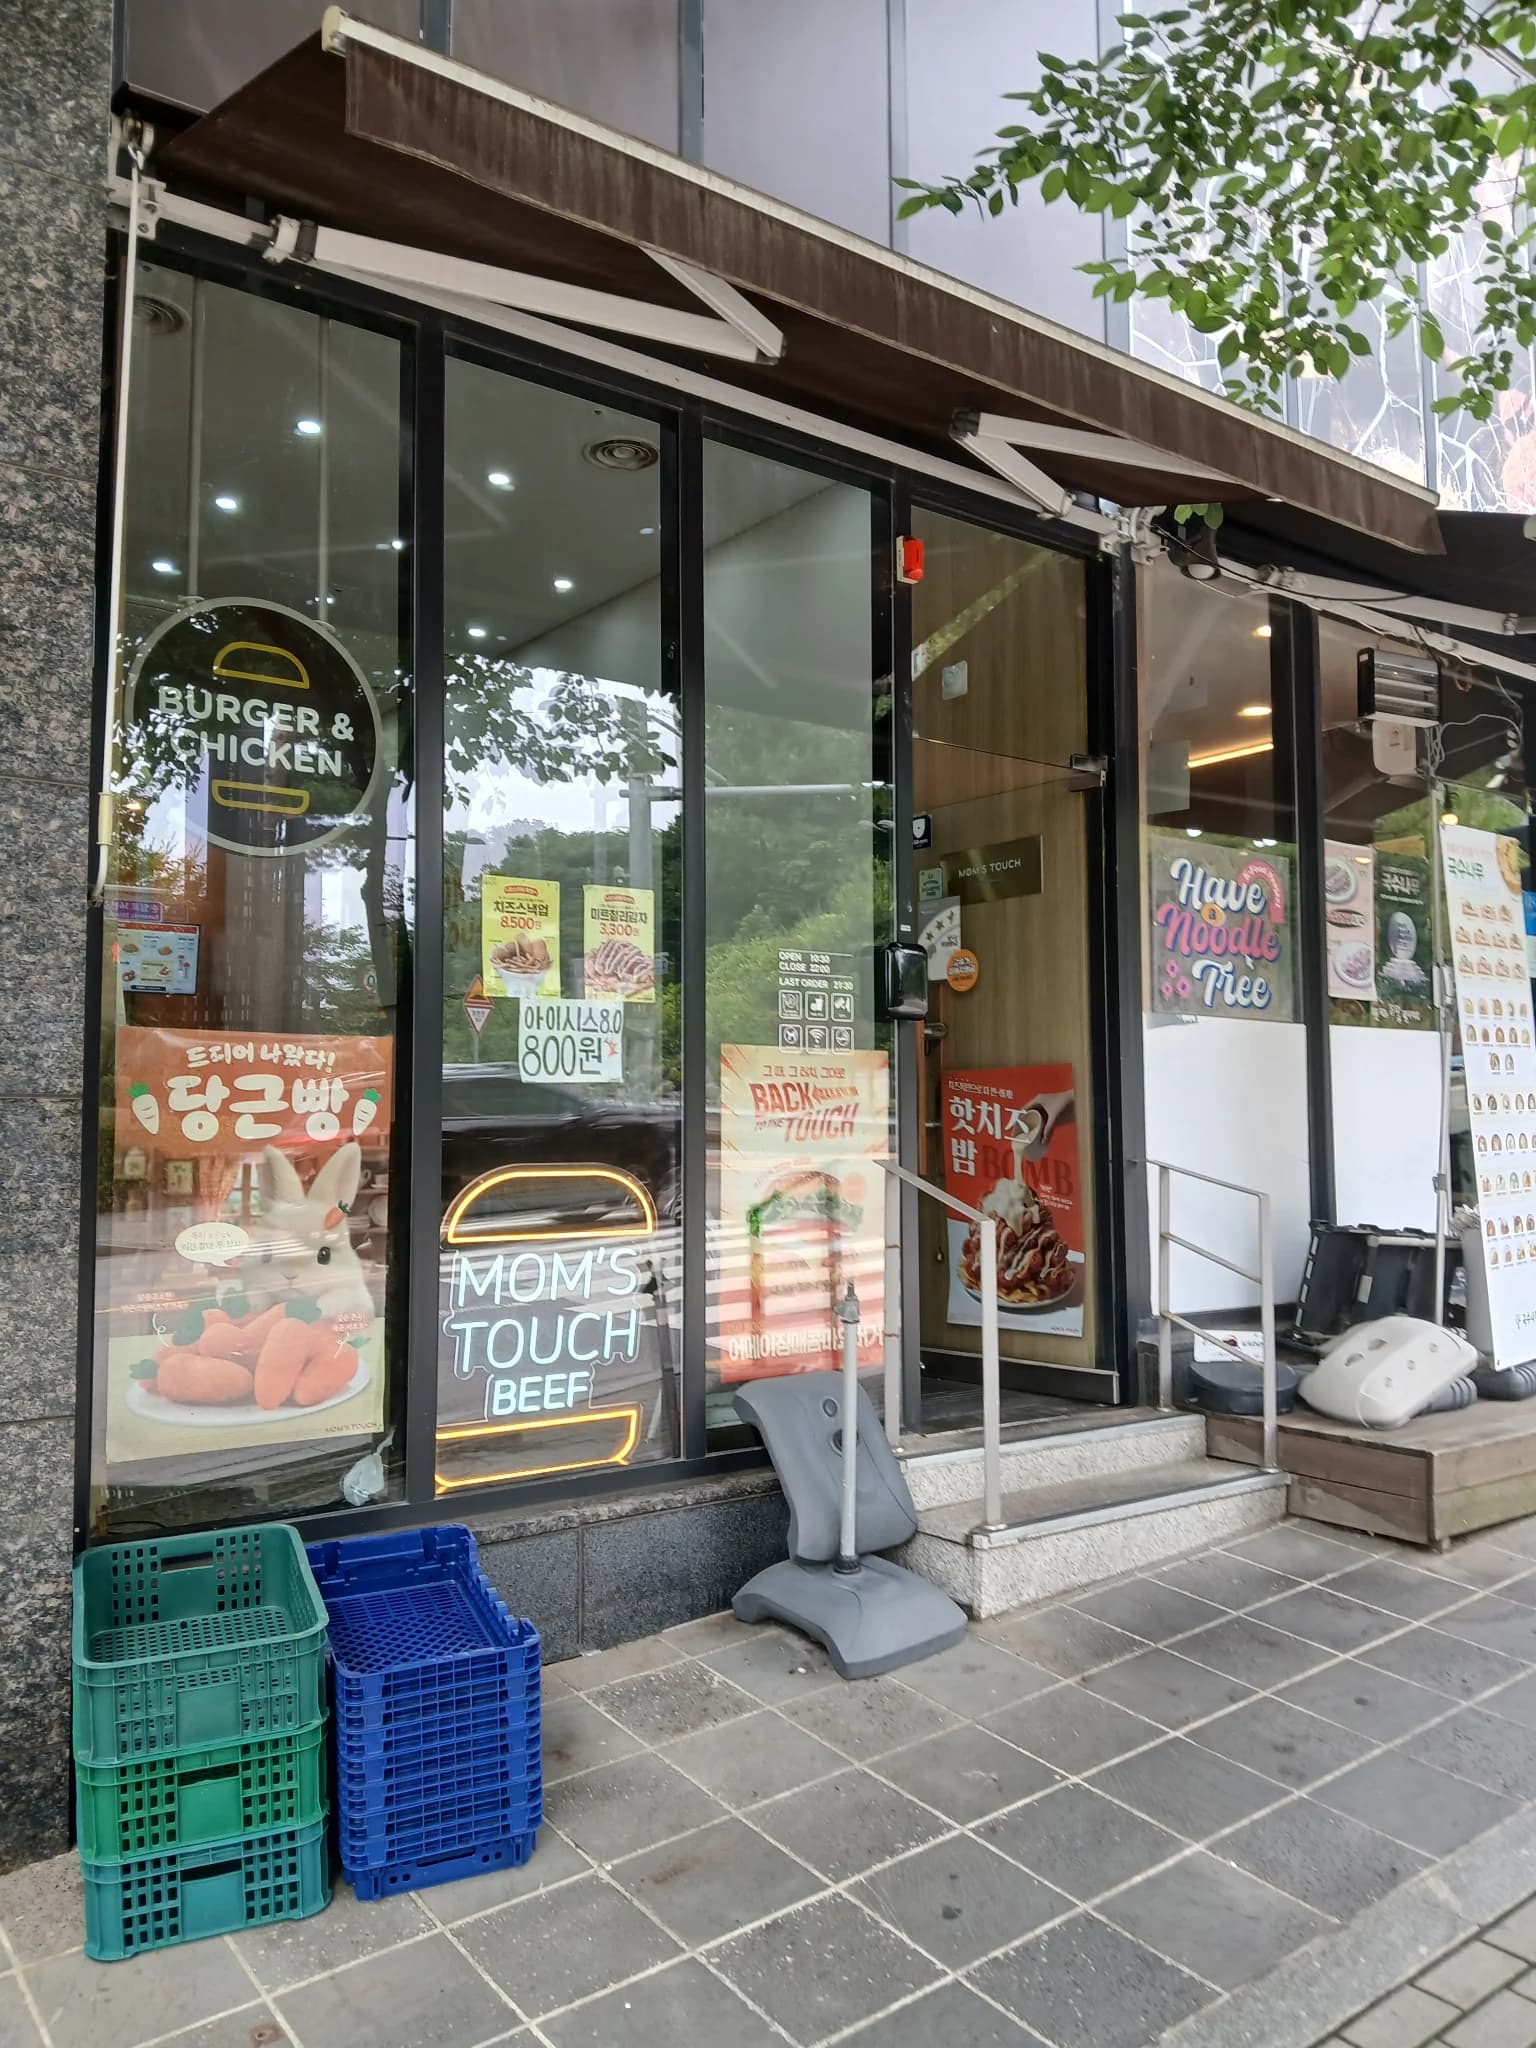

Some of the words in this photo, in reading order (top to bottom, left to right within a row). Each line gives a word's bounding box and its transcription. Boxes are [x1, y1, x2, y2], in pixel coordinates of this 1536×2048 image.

[157, 685, 320, 736] BURGER
[331, 712, 355, 742] &
[170, 730, 343, 777] CHICKEN
[958, 864, 988, 878] MOM'S
[989, 858, 1022, 873] TOUCH
[1169, 857, 1267, 915] Have
[1157, 902, 1282, 963] Noodle
[779, 951, 802, 962] OPEN
[779, 962, 807, 973] CLOSE
[779, 977, 800, 988] LAST
[801, 978, 829, 990] ORDER
[1191, 959, 1272, 1010] Tree
[524, 1005, 622, 1034] 아이시스8.0
[259, 1042, 337, 1074] 나왔다!
[521, 1034, 603, 1077] 800원
[165, 1073, 350, 1142] 당근빵
[749, 1082, 815, 1117] BACK
[948, 1095, 1032, 1144] 핫치즈
[783, 1102, 860, 1143] TOUCH
[951, 1138, 978, 1177] 밤
[458, 1247, 639, 1308] MOM'S
[450, 1308, 638, 1374] TOUCH
[491, 1370, 592, 1416] BEEF
